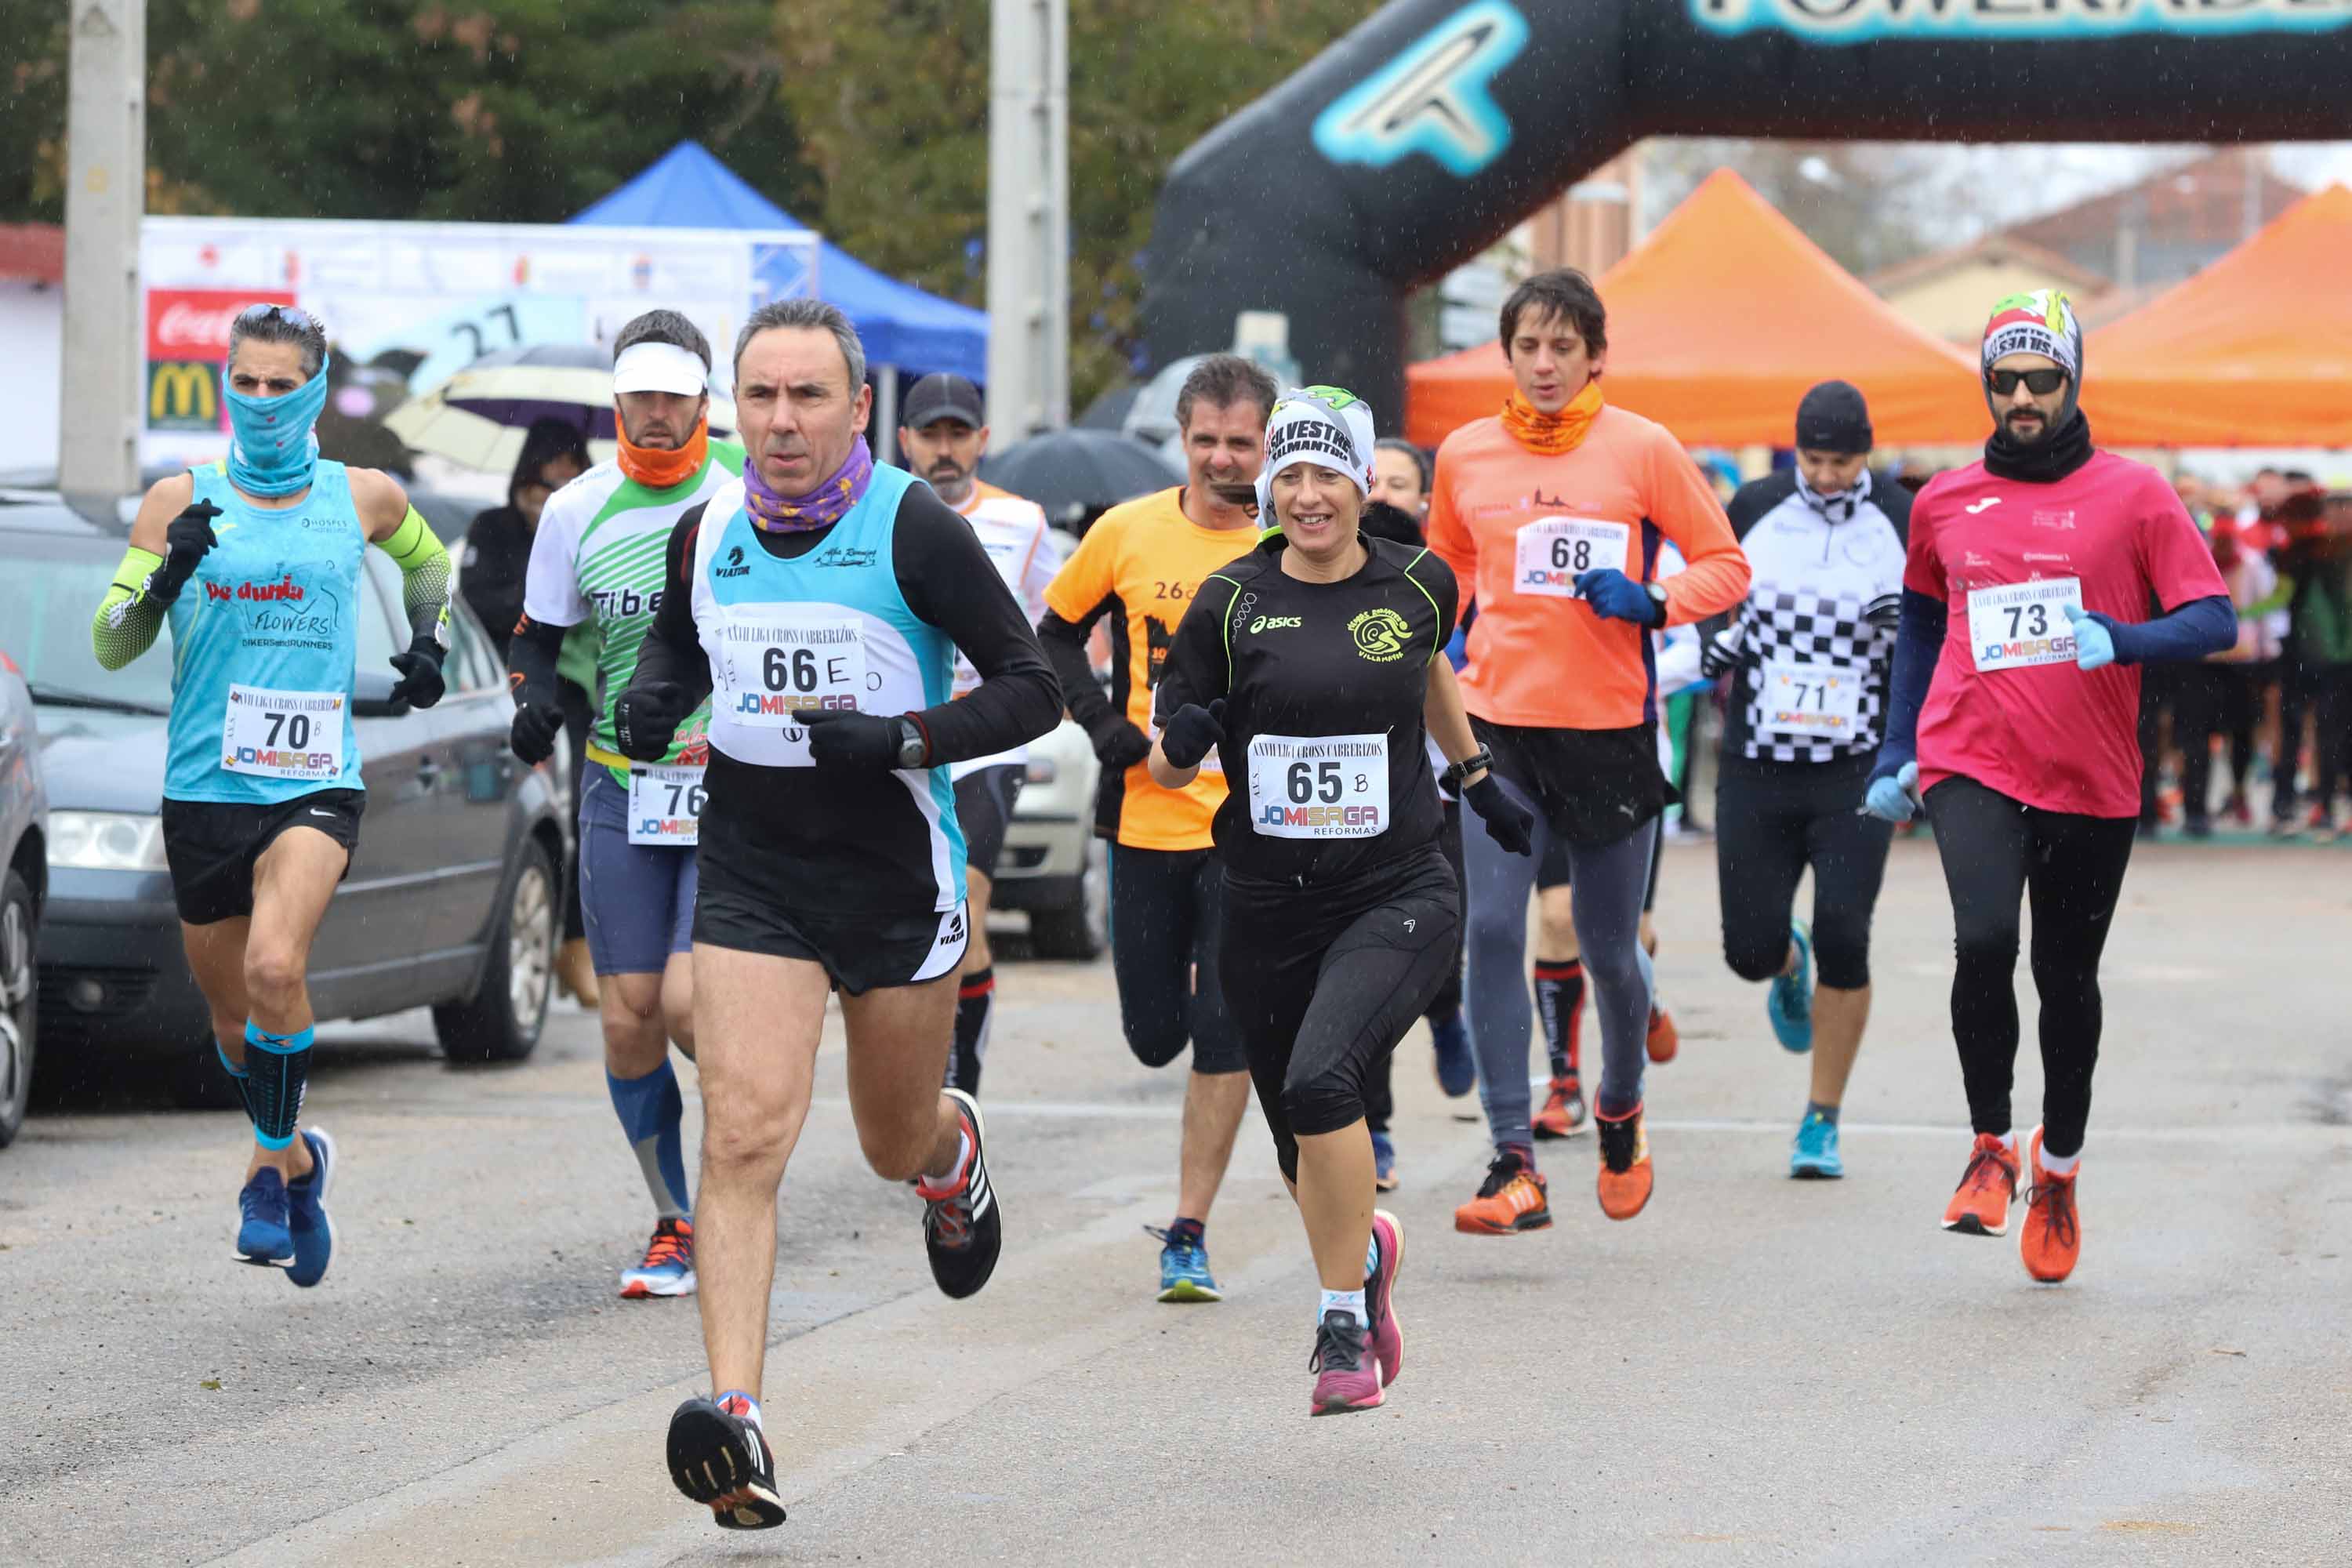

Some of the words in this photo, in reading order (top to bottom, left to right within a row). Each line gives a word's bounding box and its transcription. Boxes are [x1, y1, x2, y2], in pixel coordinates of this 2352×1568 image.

[1271, 420, 1352, 454] SILVESTRE
[1551, 537, 1592, 571] 68
[715, 565, 750, 578] VIATOR
[1155, 581, 1183, 600] 26
[255, 610, 329, 634] FLOWERS
[1266, 616, 1302, 629] asics
[2003, 604, 2049, 639] 73
[772, 628, 799, 643] CROSS
[800, 628, 858, 644] CABRERIZOS
[762, 647, 818, 693] 66
[826, 656, 851, 684] E
[299, 699, 334, 711] CABRERIZ
[736, 691, 858, 716] JOMISAGA
[1794, 683, 1825, 710] 71
[264, 712, 310, 750] 70
[235, 745, 332, 770] JOMISAGA
[1297, 745, 1326, 759] CROSS
[1327, 742, 1382, 757] CABRERIZOS
[1287, 761, 1343, 804] 65
[1353, 773, 1369, 793] B
[664, 784, 706, 817] 76
[1259, 805, 1379, 826] JOMISAGA
[1313, 826, 1377, 836] REFORMAS
